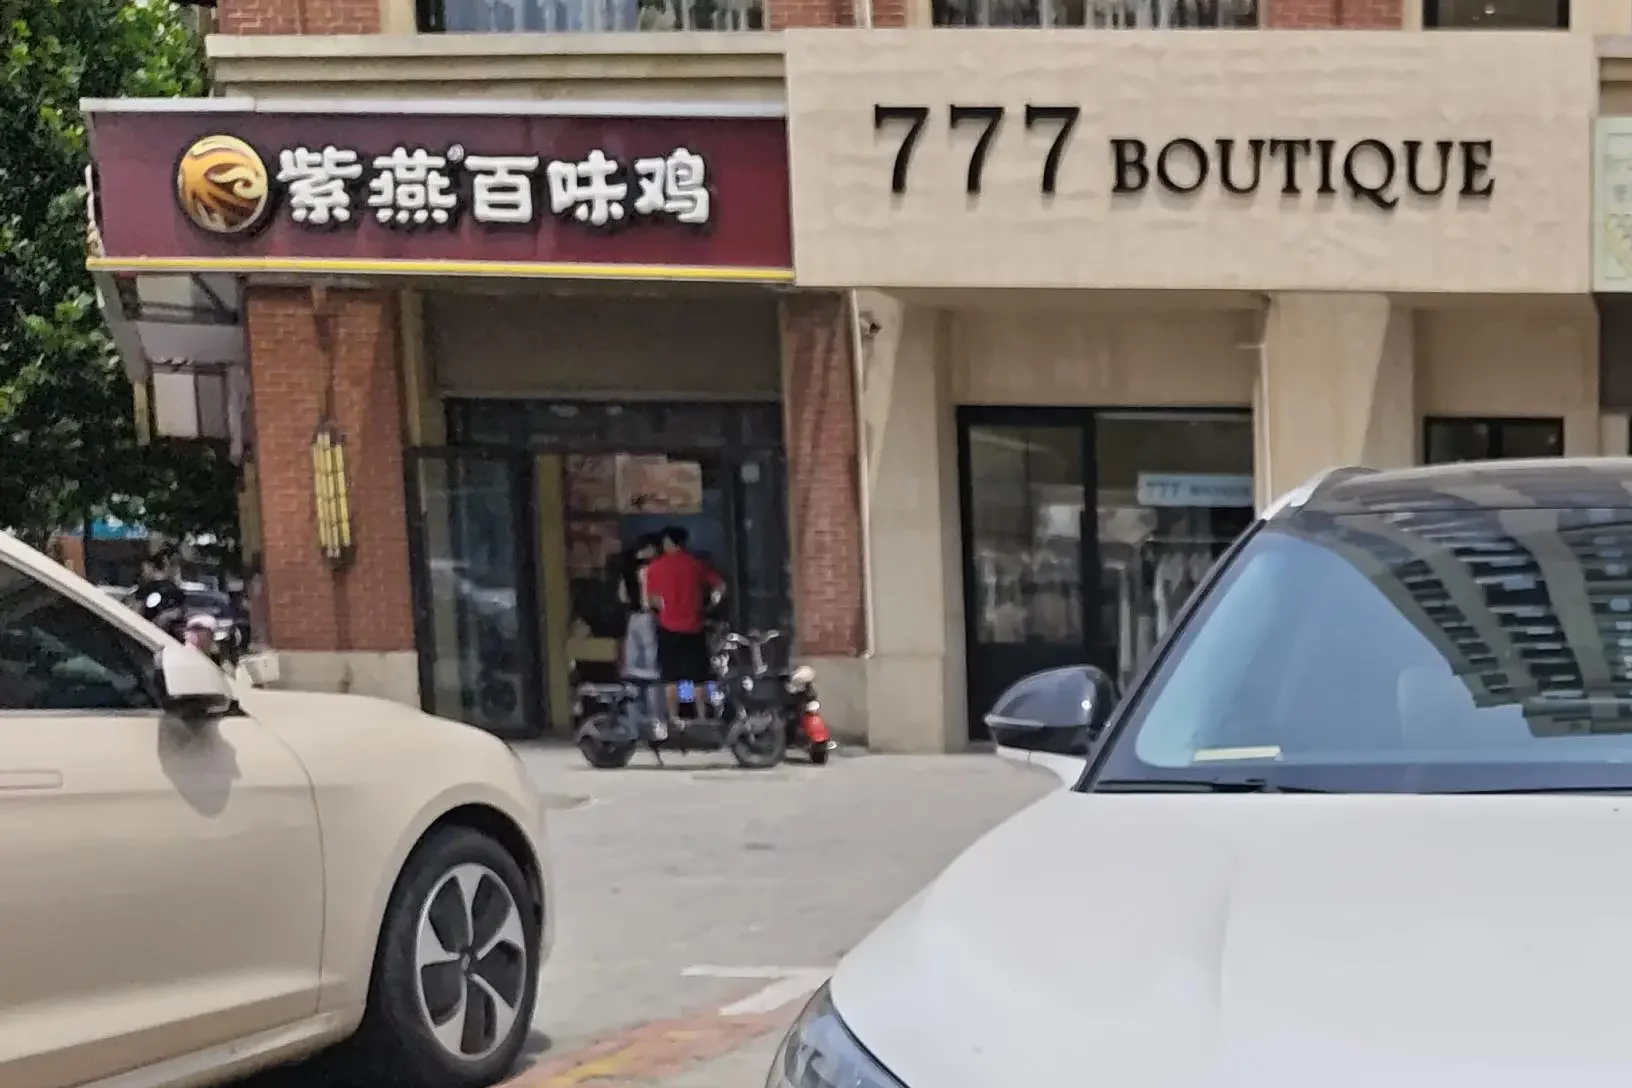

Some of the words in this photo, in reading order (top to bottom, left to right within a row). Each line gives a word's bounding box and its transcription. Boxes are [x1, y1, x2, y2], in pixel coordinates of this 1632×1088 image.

[276, 145, 711, 225] 紫燕百味鸡
[874, 102, 1081, 195] 777
[1109, 137, 1496, 210] BOUTIQUE
